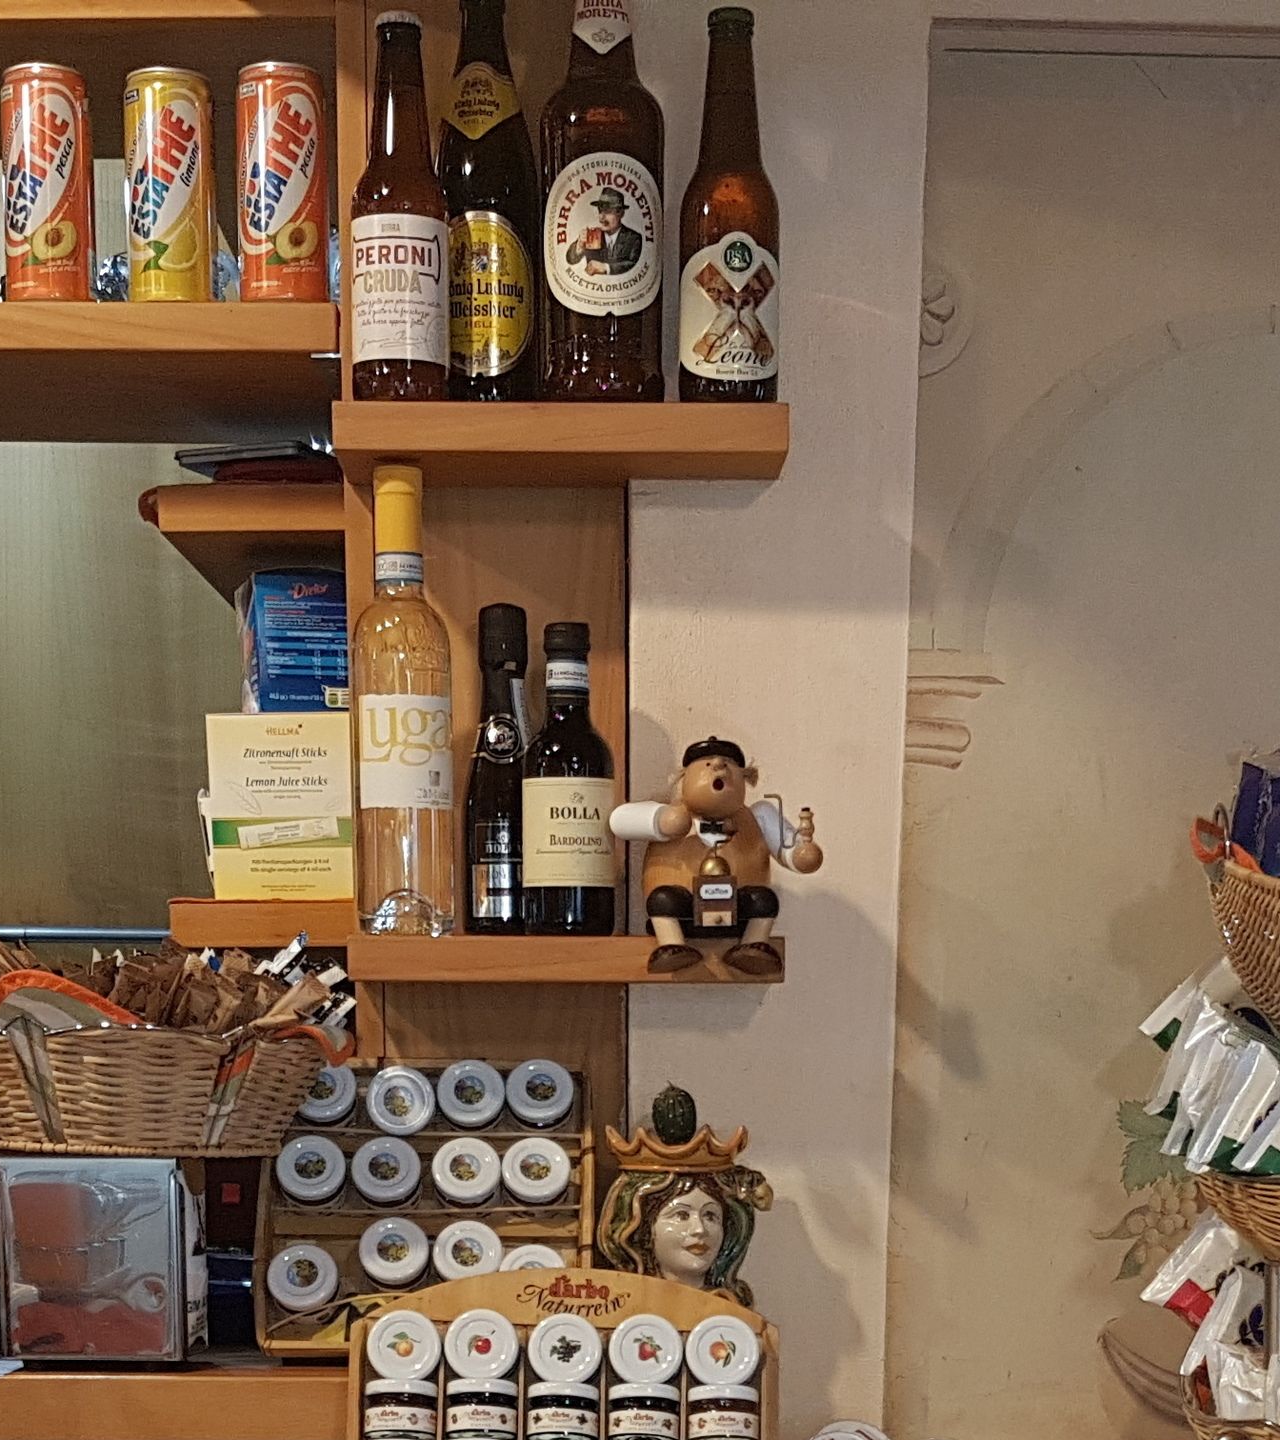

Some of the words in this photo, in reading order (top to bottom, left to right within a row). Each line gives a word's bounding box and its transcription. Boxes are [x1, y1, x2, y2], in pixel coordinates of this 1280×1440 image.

[54, 138, 74, 180] pesca
[179, 140, 200, 187] limone
[299, 137, 316, 180] pesca
[557, 178, 593, 245] BIRRA
[596, 172, 655, 243] MORETTI
[355, 245, 432, 268] PERONI
[363, 269, 422, 294] CRUDA
[449, 280, 473, 296] önig
[477, 279, 524, 303] Ludwig
[243, 747, 300, 760] Zitronensaft
[301, 747, 328, 758] Sticks
[245, 776, 275, 788] Lemon
[277, 776, 300, 788] Juice
[302, 776, 328, 787] Sticks
[549, 806, 601, 822] BOLLA
[516, 1284, 631, 1317] Naturrein
